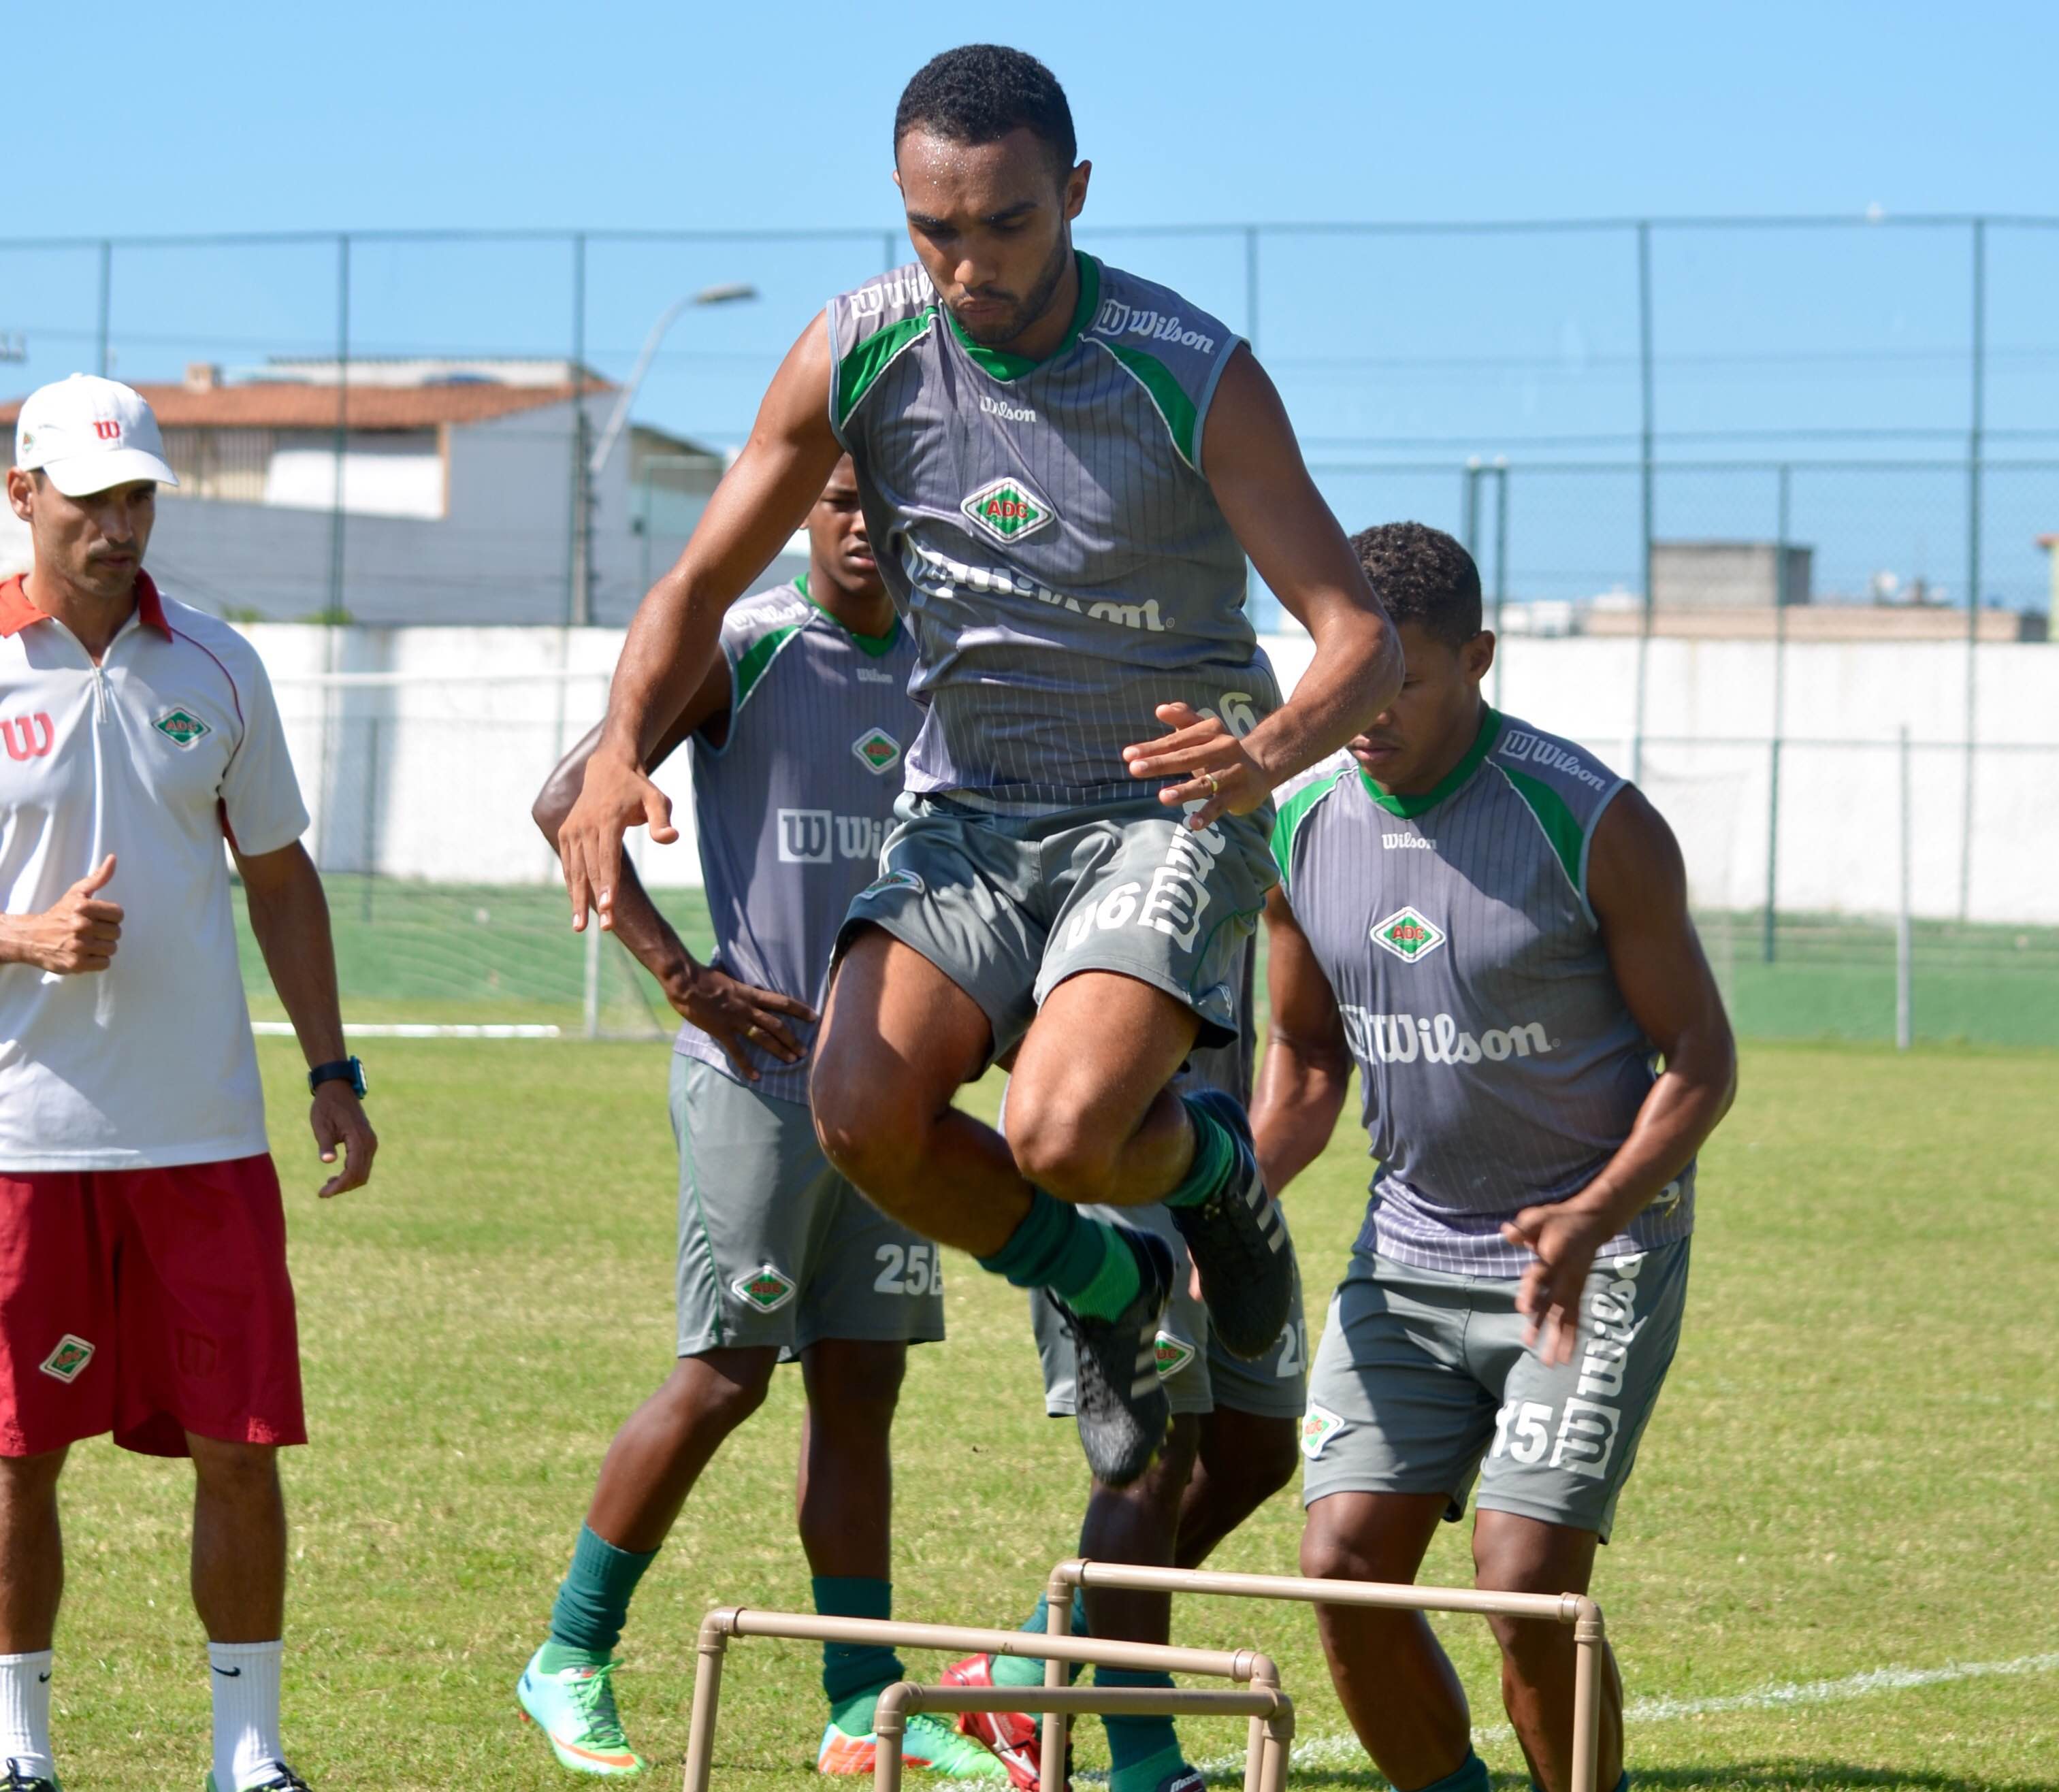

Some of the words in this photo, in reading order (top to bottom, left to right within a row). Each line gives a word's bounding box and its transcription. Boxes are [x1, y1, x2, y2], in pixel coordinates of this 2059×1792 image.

[1128, 310, 1214, 354] Wilson
[979, 393, 1037, 423] Wilson
[93, 419, 120, 440] W
[986, 500, 1027, 519] ADC
[0, 712, 54, 761] W
[1532, 740, 1606, 791] Wilson
[1381, 832, 1437, 849] Wilson
[1392, 926, 1424, 940] ADC
[1369, 1013, 1552, 1064] Wilson
[873, 1243, 930, 1295] 25
